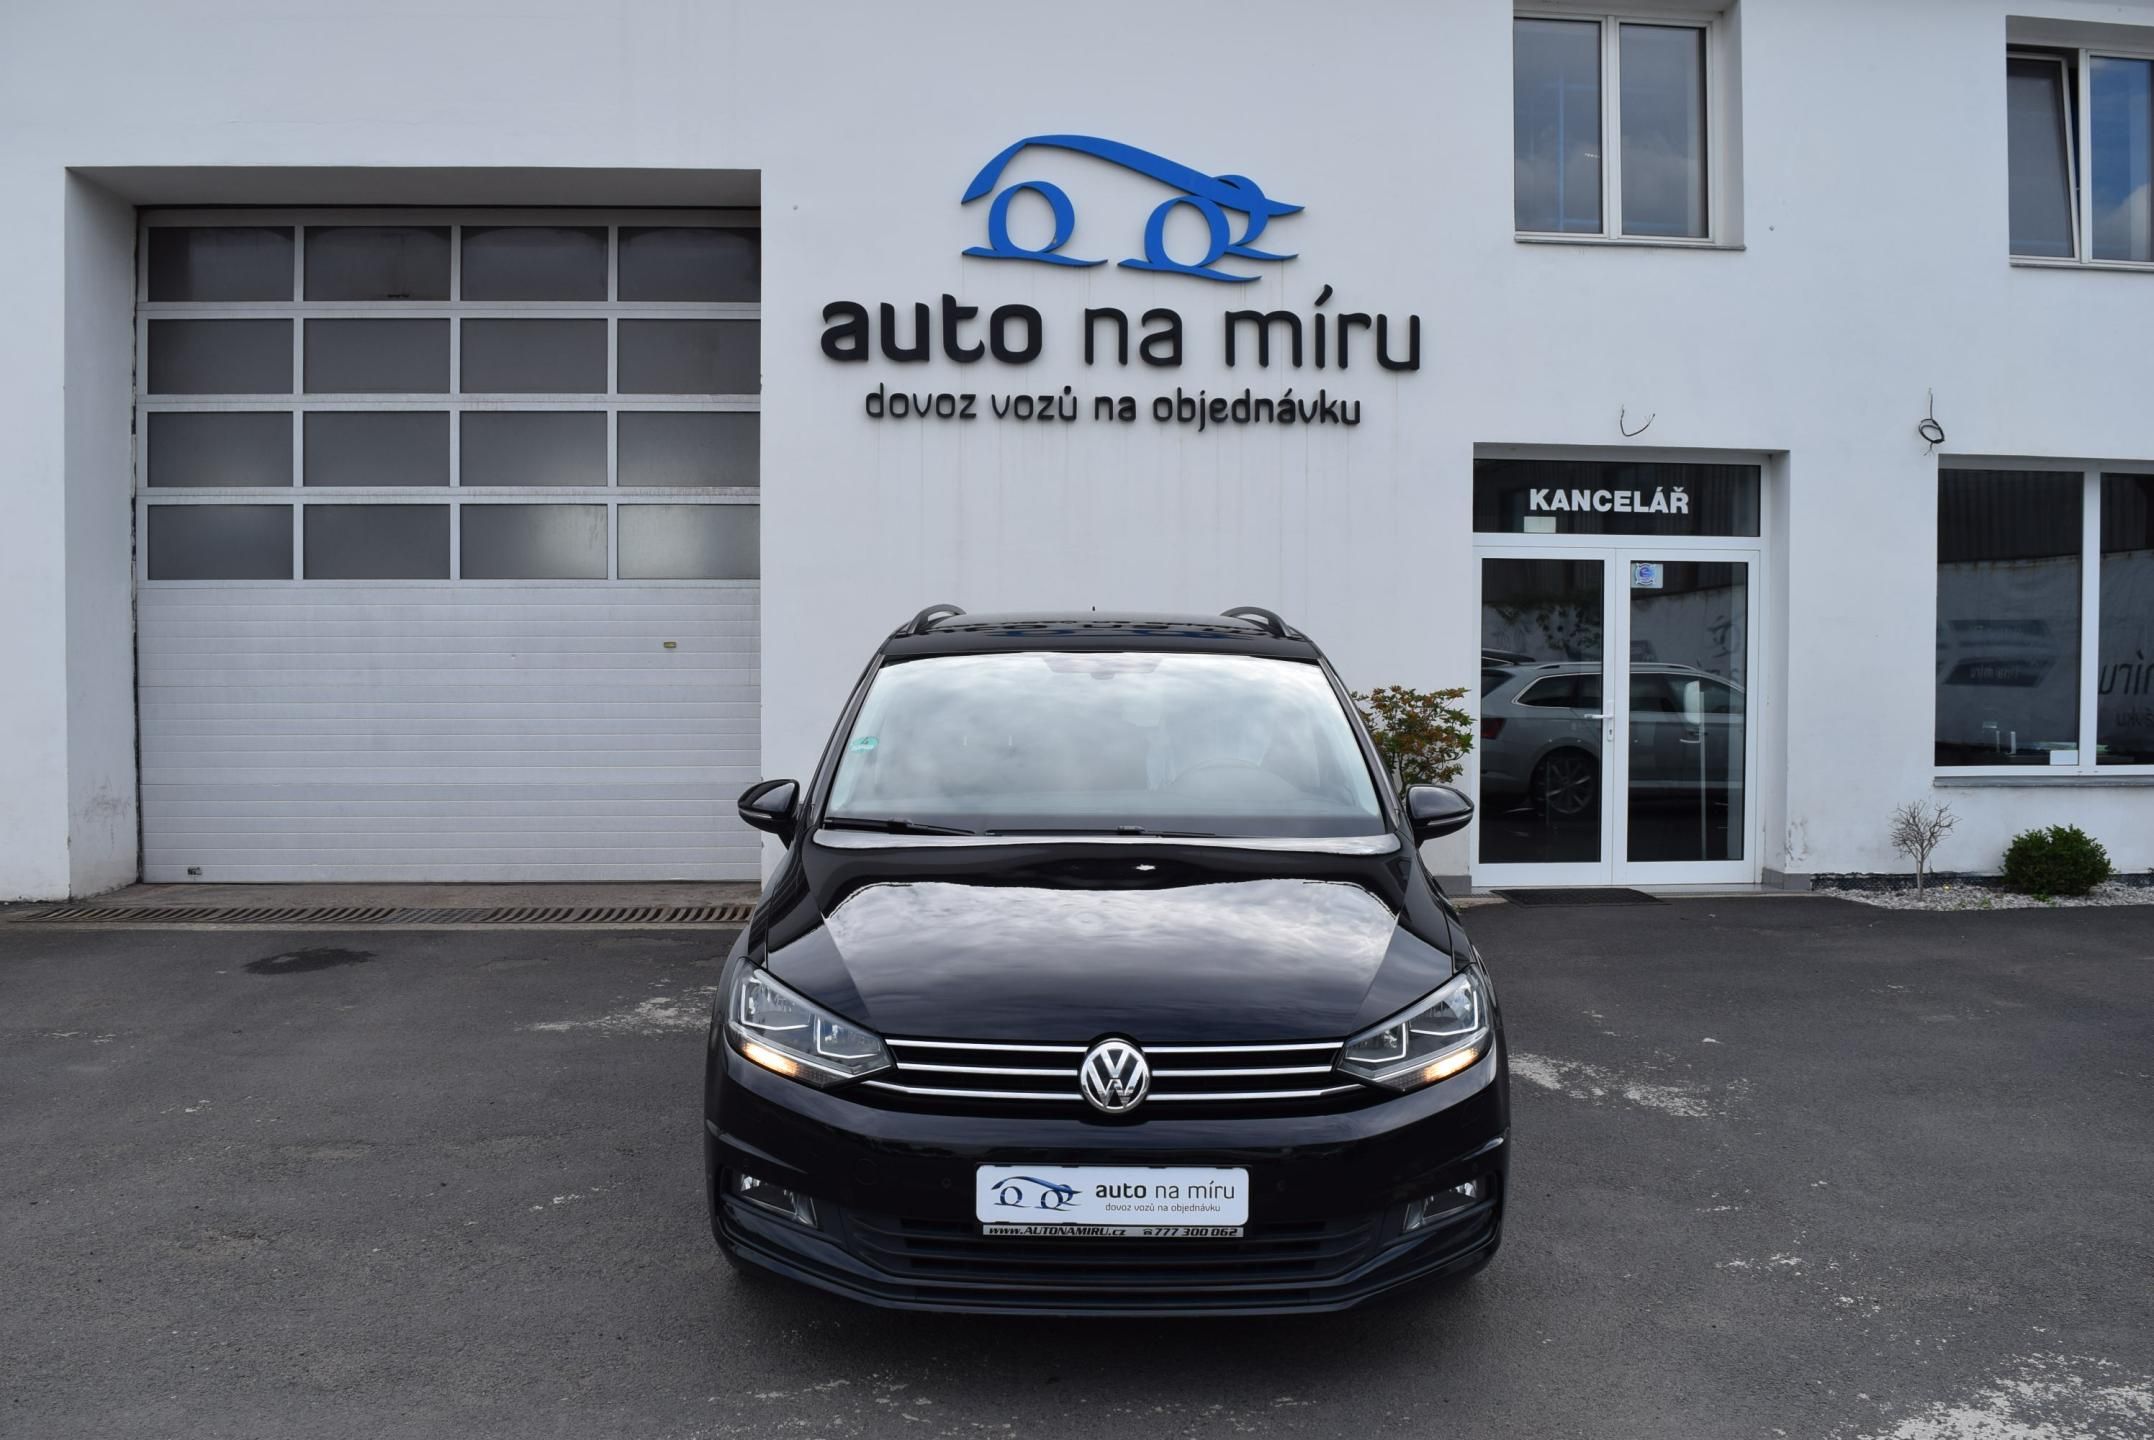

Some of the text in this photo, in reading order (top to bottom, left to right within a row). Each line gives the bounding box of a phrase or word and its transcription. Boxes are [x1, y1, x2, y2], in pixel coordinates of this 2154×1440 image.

[820, 284, 1421, 371] auto na míru
[865, 382, 1361, 432] dovoz vozů na objednávku
[1529, 486, 1689, 514] KANCELÁŘ
[1095, 1180, 1235, 1199] auto na míru
[1105, 1202, 1221, 1214] dovoz vozů na objednávku
[989, 1226, 1238, 1237] www.AUTONAMIRU.cz 777 300 062
